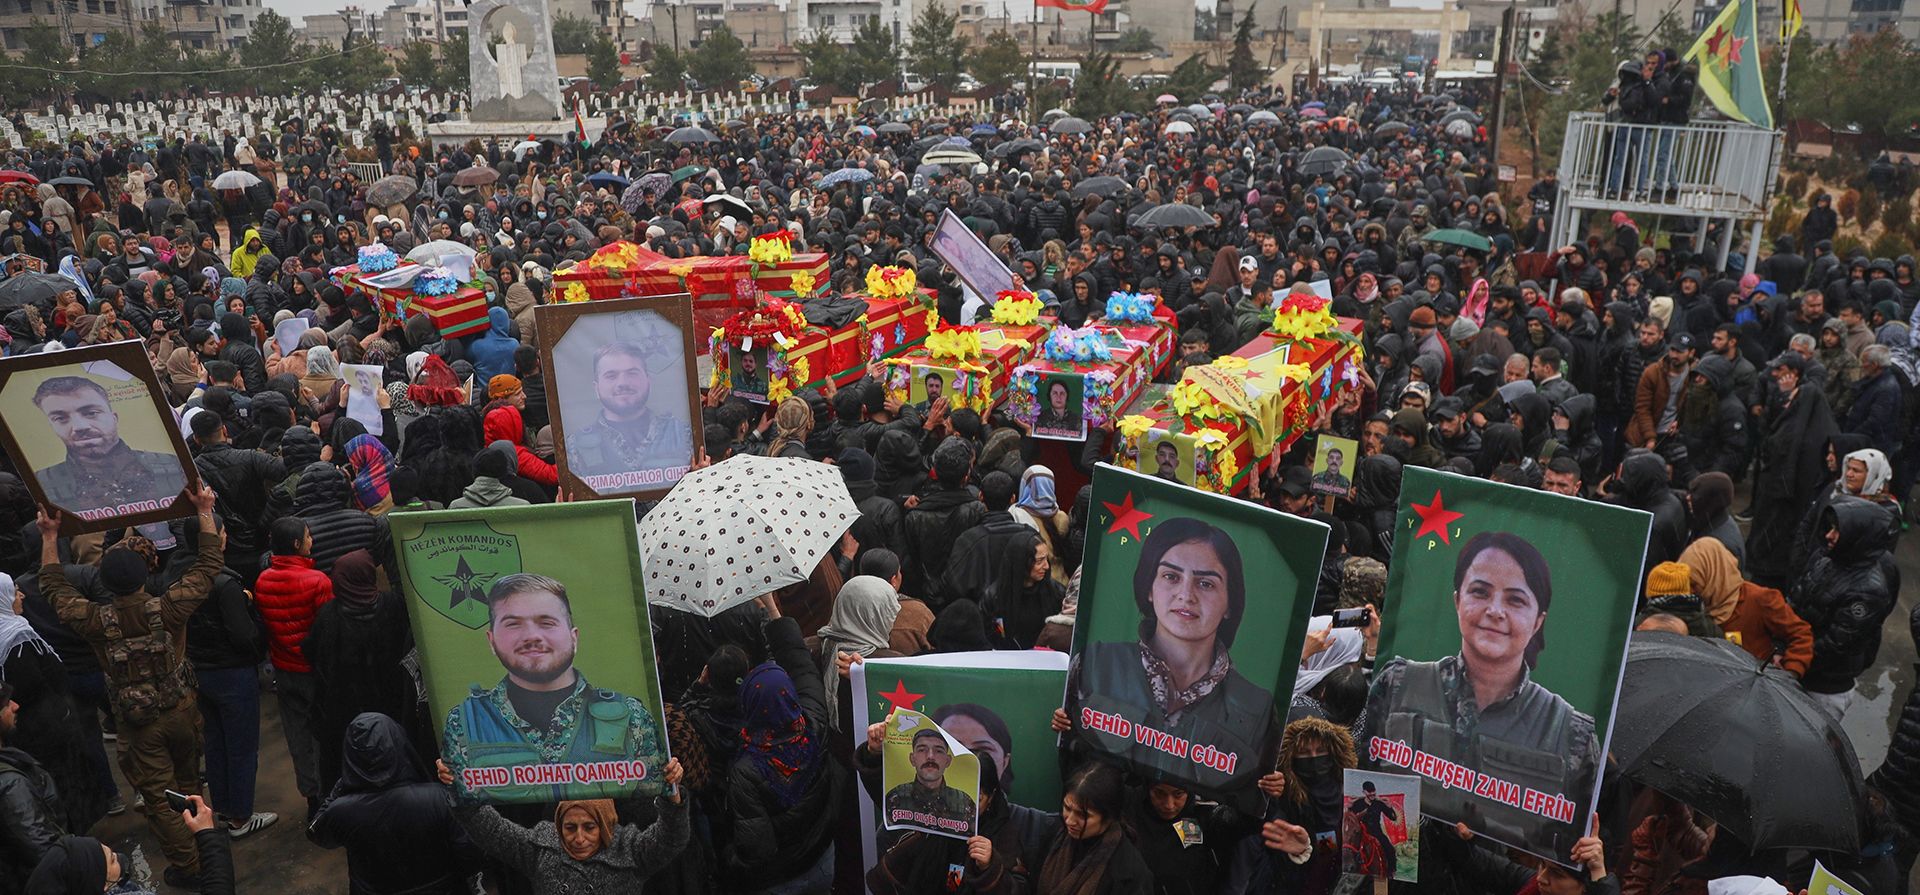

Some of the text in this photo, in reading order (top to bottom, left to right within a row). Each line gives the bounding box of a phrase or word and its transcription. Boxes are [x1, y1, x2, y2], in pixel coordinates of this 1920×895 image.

[448, 535, 512, 547] KOMANDOS
[1082, 707, 1237, 774] ŞEHÎD VIYAN CÛDÎ
[463, 761, 646, 790] ŞEHID ROJHAT QAMIŞLO
[1369, 737, 1575, 824] ŞEHÎD REWŞEN ZANA EFRÎN
